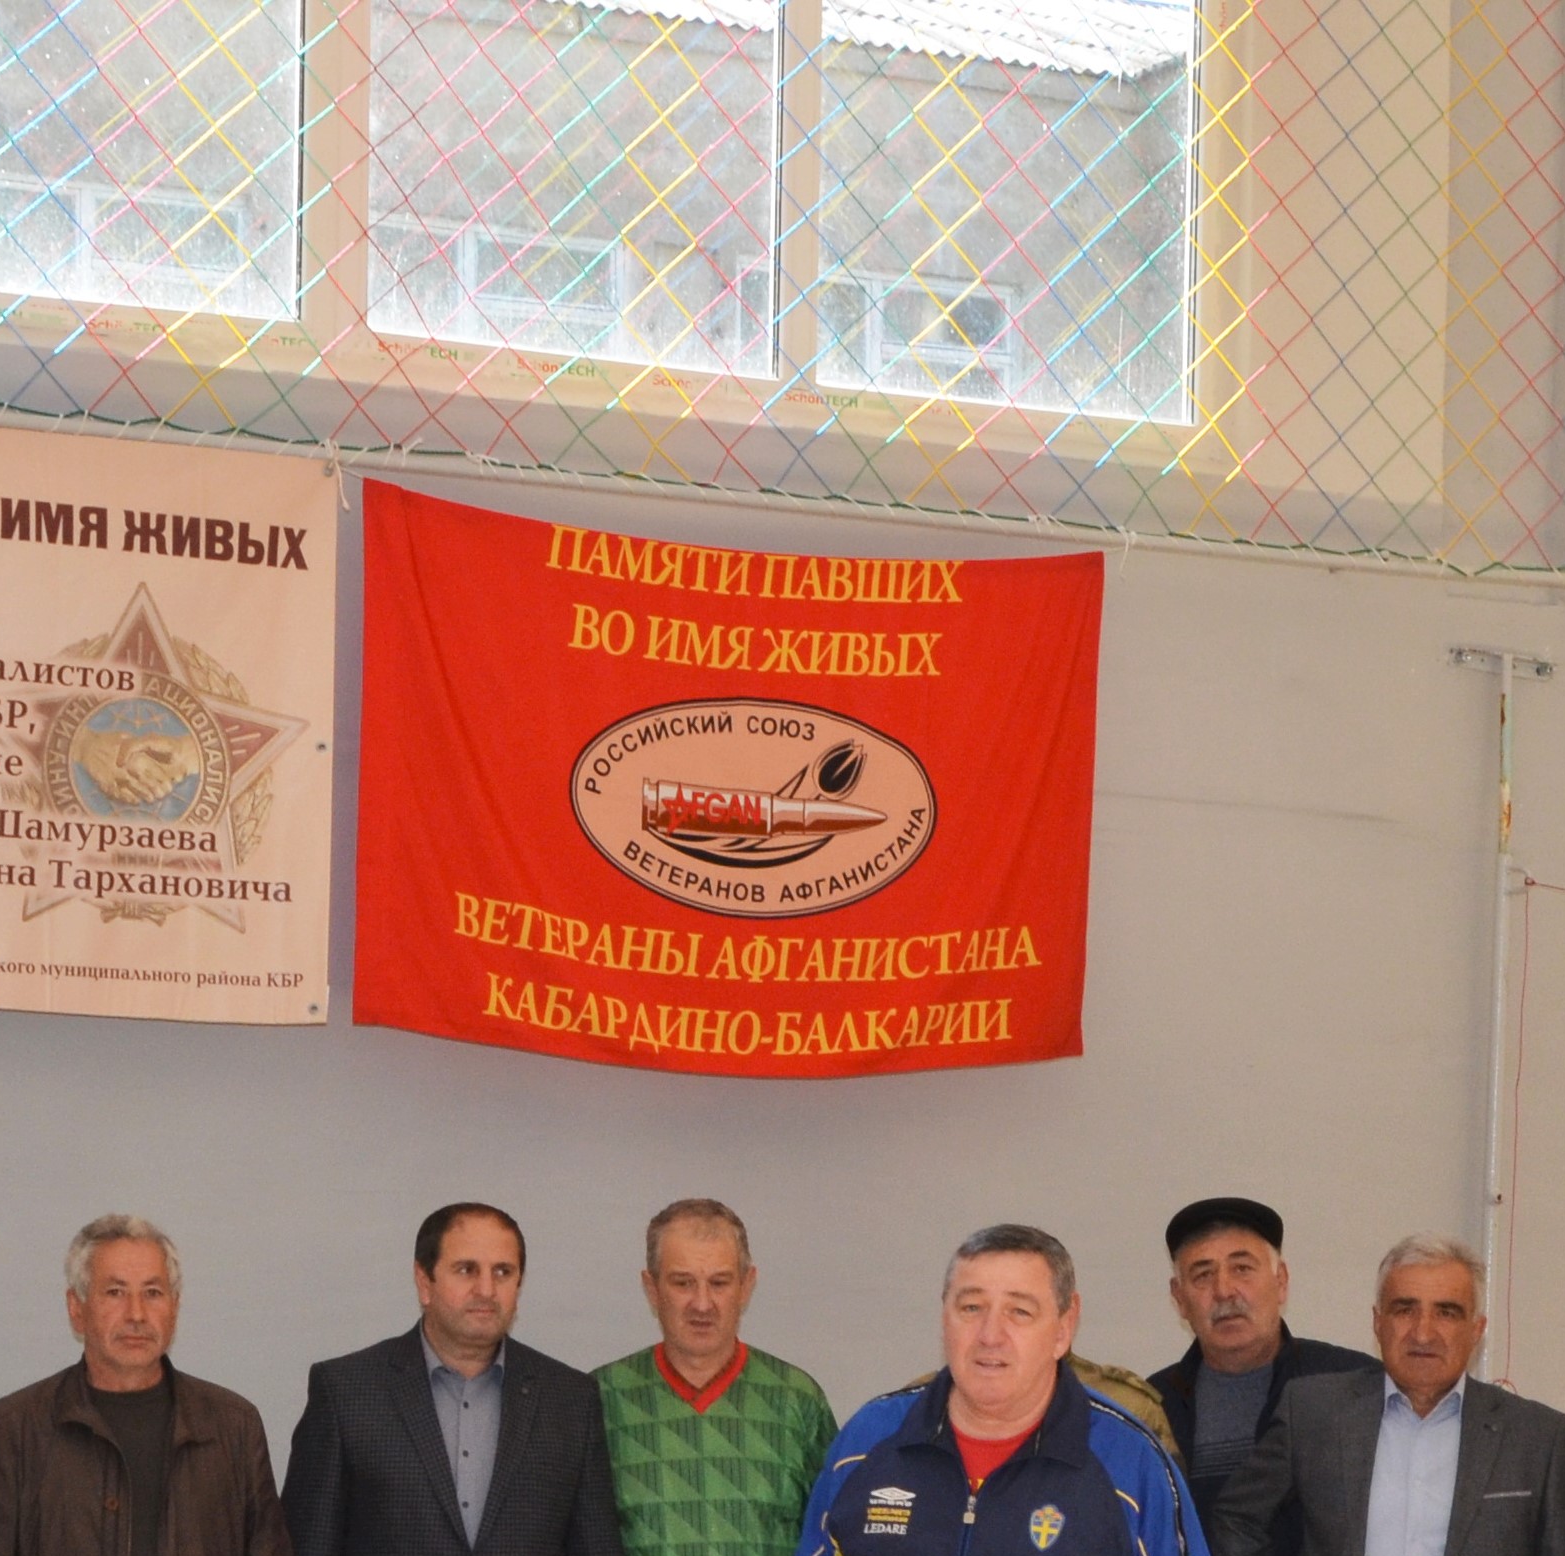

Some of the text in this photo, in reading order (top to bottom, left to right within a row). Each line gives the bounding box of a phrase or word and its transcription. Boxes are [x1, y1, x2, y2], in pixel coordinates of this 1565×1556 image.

[0, 497, 109, 550] ИМЯ
[122, 509, 310, 572] ЖИВЫХ
[545, 523, 964, 604] ПАМЯТИ ПАВШИХ
[568, 603, 943, 678] ВО ИМЯ ЖИВЫХ
[584, 709, 816, 795] РОССИЙСКИЙ СОЮЗ
[661, 782, 763, 838] AFGAN
[48, 857, 293, 903] Тархановича
[622, 805, 927, 904] ВЕТЕРАНОВ АФГАНИСТАНА
[453, 890, 1042, 984] ВЕТЕРАНЫ АФГАНИСТАНА
[40, 962, 192, 990] муниципального
[196, 969, 262, 991] района
[266, 970, 305, 990] КБР
[482, 970, 1014, 1058] КАБАРДИНО-БАЛКАРИИ
[863, 1522, 908, 1535] LEDARE
